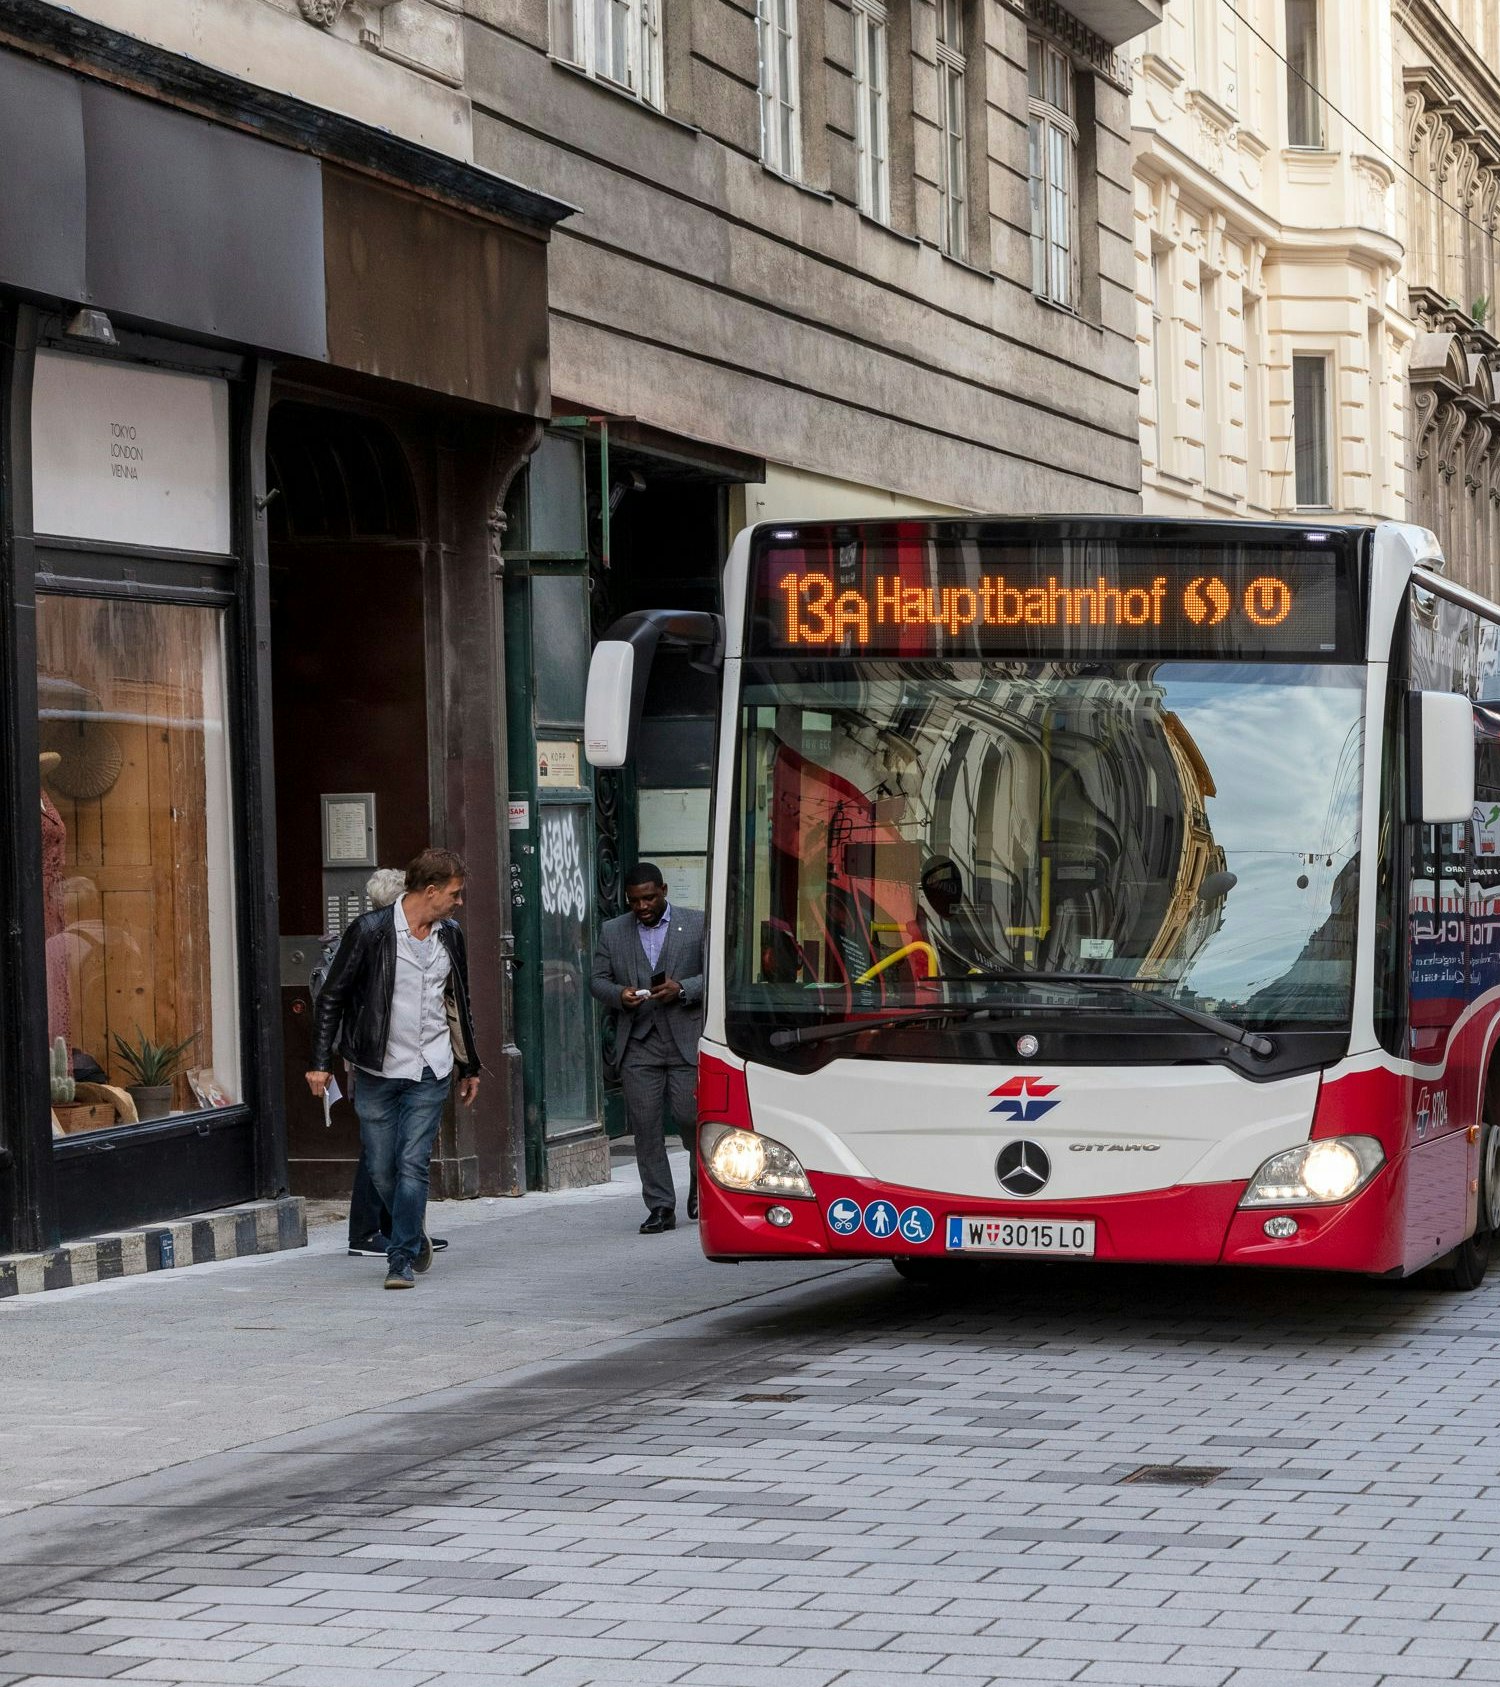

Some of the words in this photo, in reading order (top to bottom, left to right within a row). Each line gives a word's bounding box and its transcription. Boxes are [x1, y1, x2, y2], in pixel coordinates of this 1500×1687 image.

[110, 422, 137, 440] TOKYO
[111, 443, 143, 461] LONDON
[111, 463, 138, 479] VIENNA
[780, 573, 869, 643] 13A
[877, 576, 1167, 636] Hauptbahnhof
[1432, 1089, 1448, 1128] 8784
[1069, 1143, 1161, 1152] CITARO
[969, 1223, 984, 1245] W
[1002, 1225, 1053, 1247] 3015
